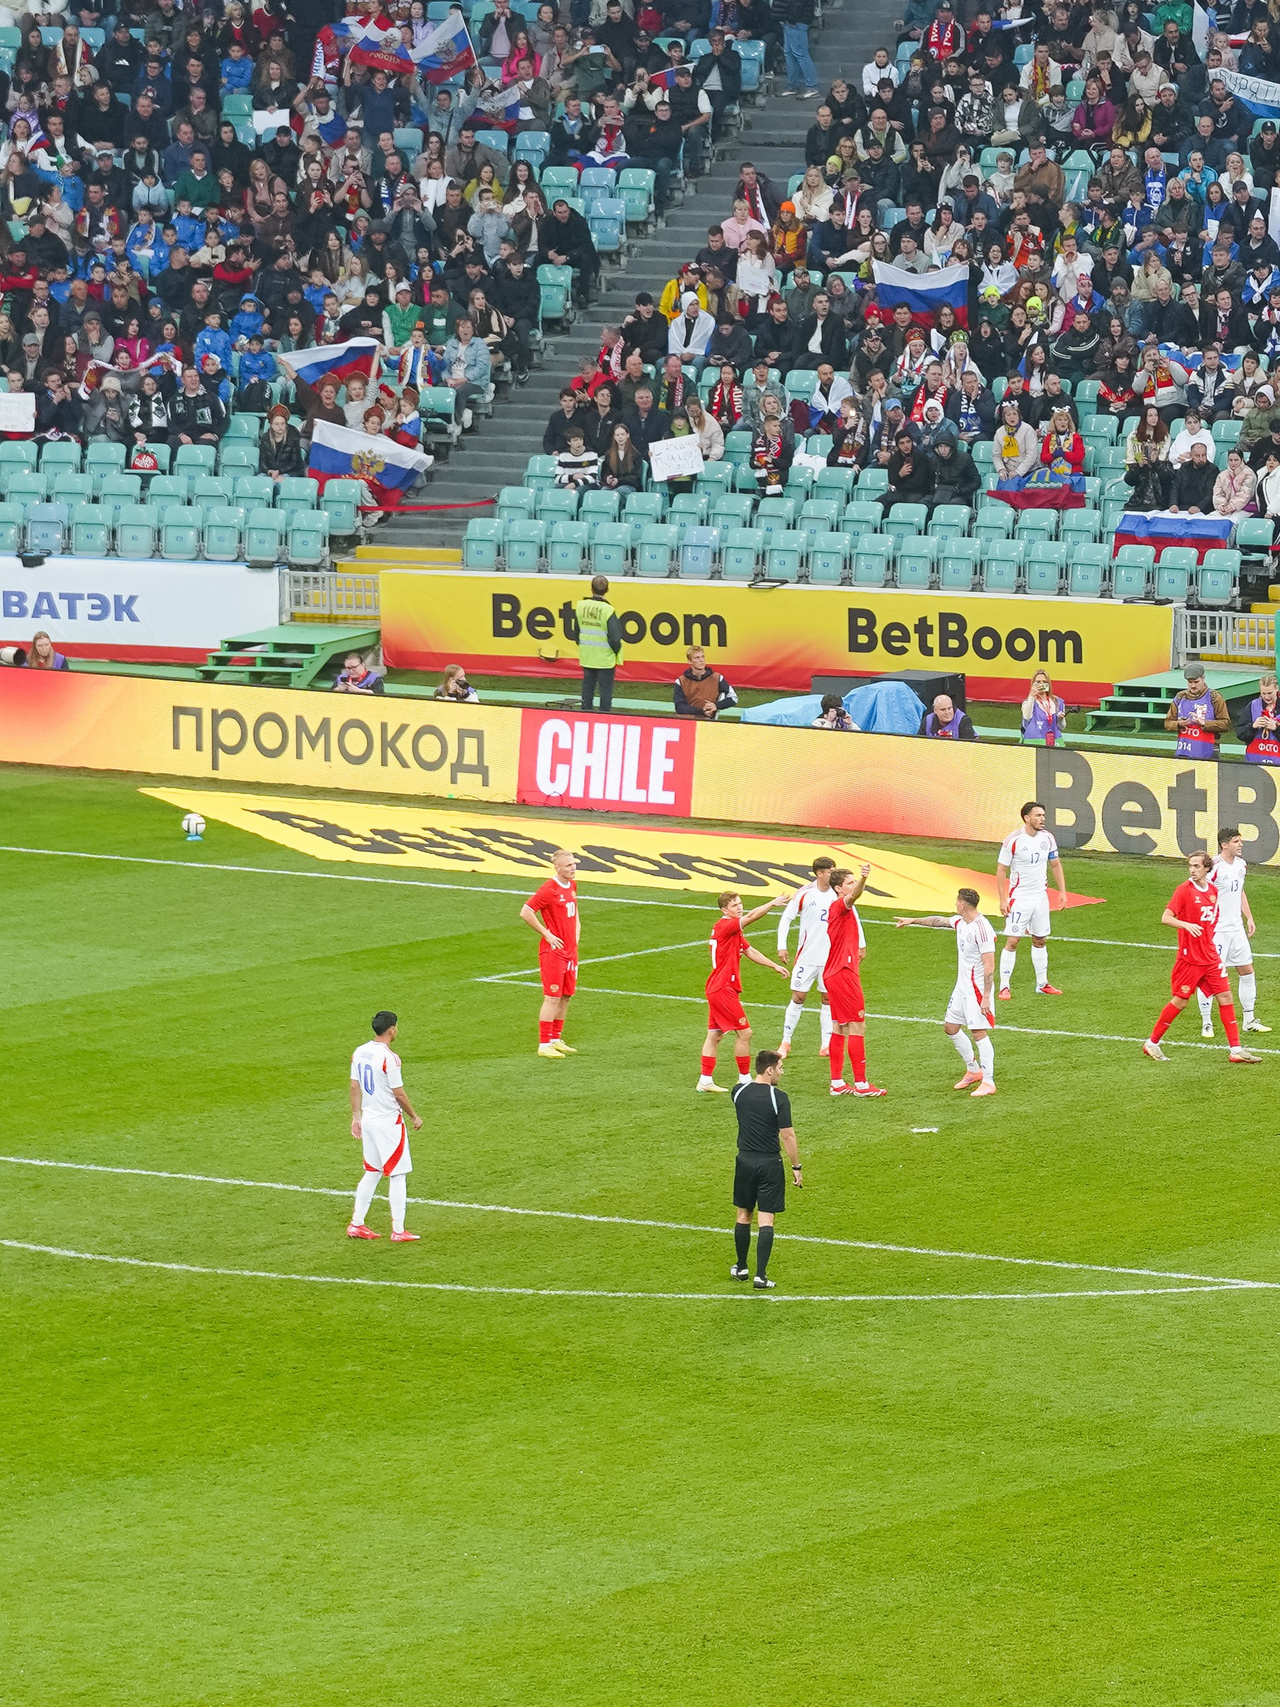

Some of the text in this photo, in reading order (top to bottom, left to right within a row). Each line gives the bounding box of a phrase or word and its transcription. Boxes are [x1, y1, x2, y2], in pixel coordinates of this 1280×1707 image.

[2, 590, 141, 622] ВАТЭК
[492, 592, 727, 647] Betoom
[848, 608, 1082, 664] BetBoom
[172, 704, 490, 787] промокод
[536, 718, 682, 804] CHILE
[1031, 852, 1040, 864] 17
[1231, 879, 1239, 892] 13
[565, 901, 576, 918] 10
[1011, 911, 1022, 924] 17
[1200, 905, 1214, 922] 25
[1217, 944, 1223, 956] 3
[796, 966, 804, 979] 2
